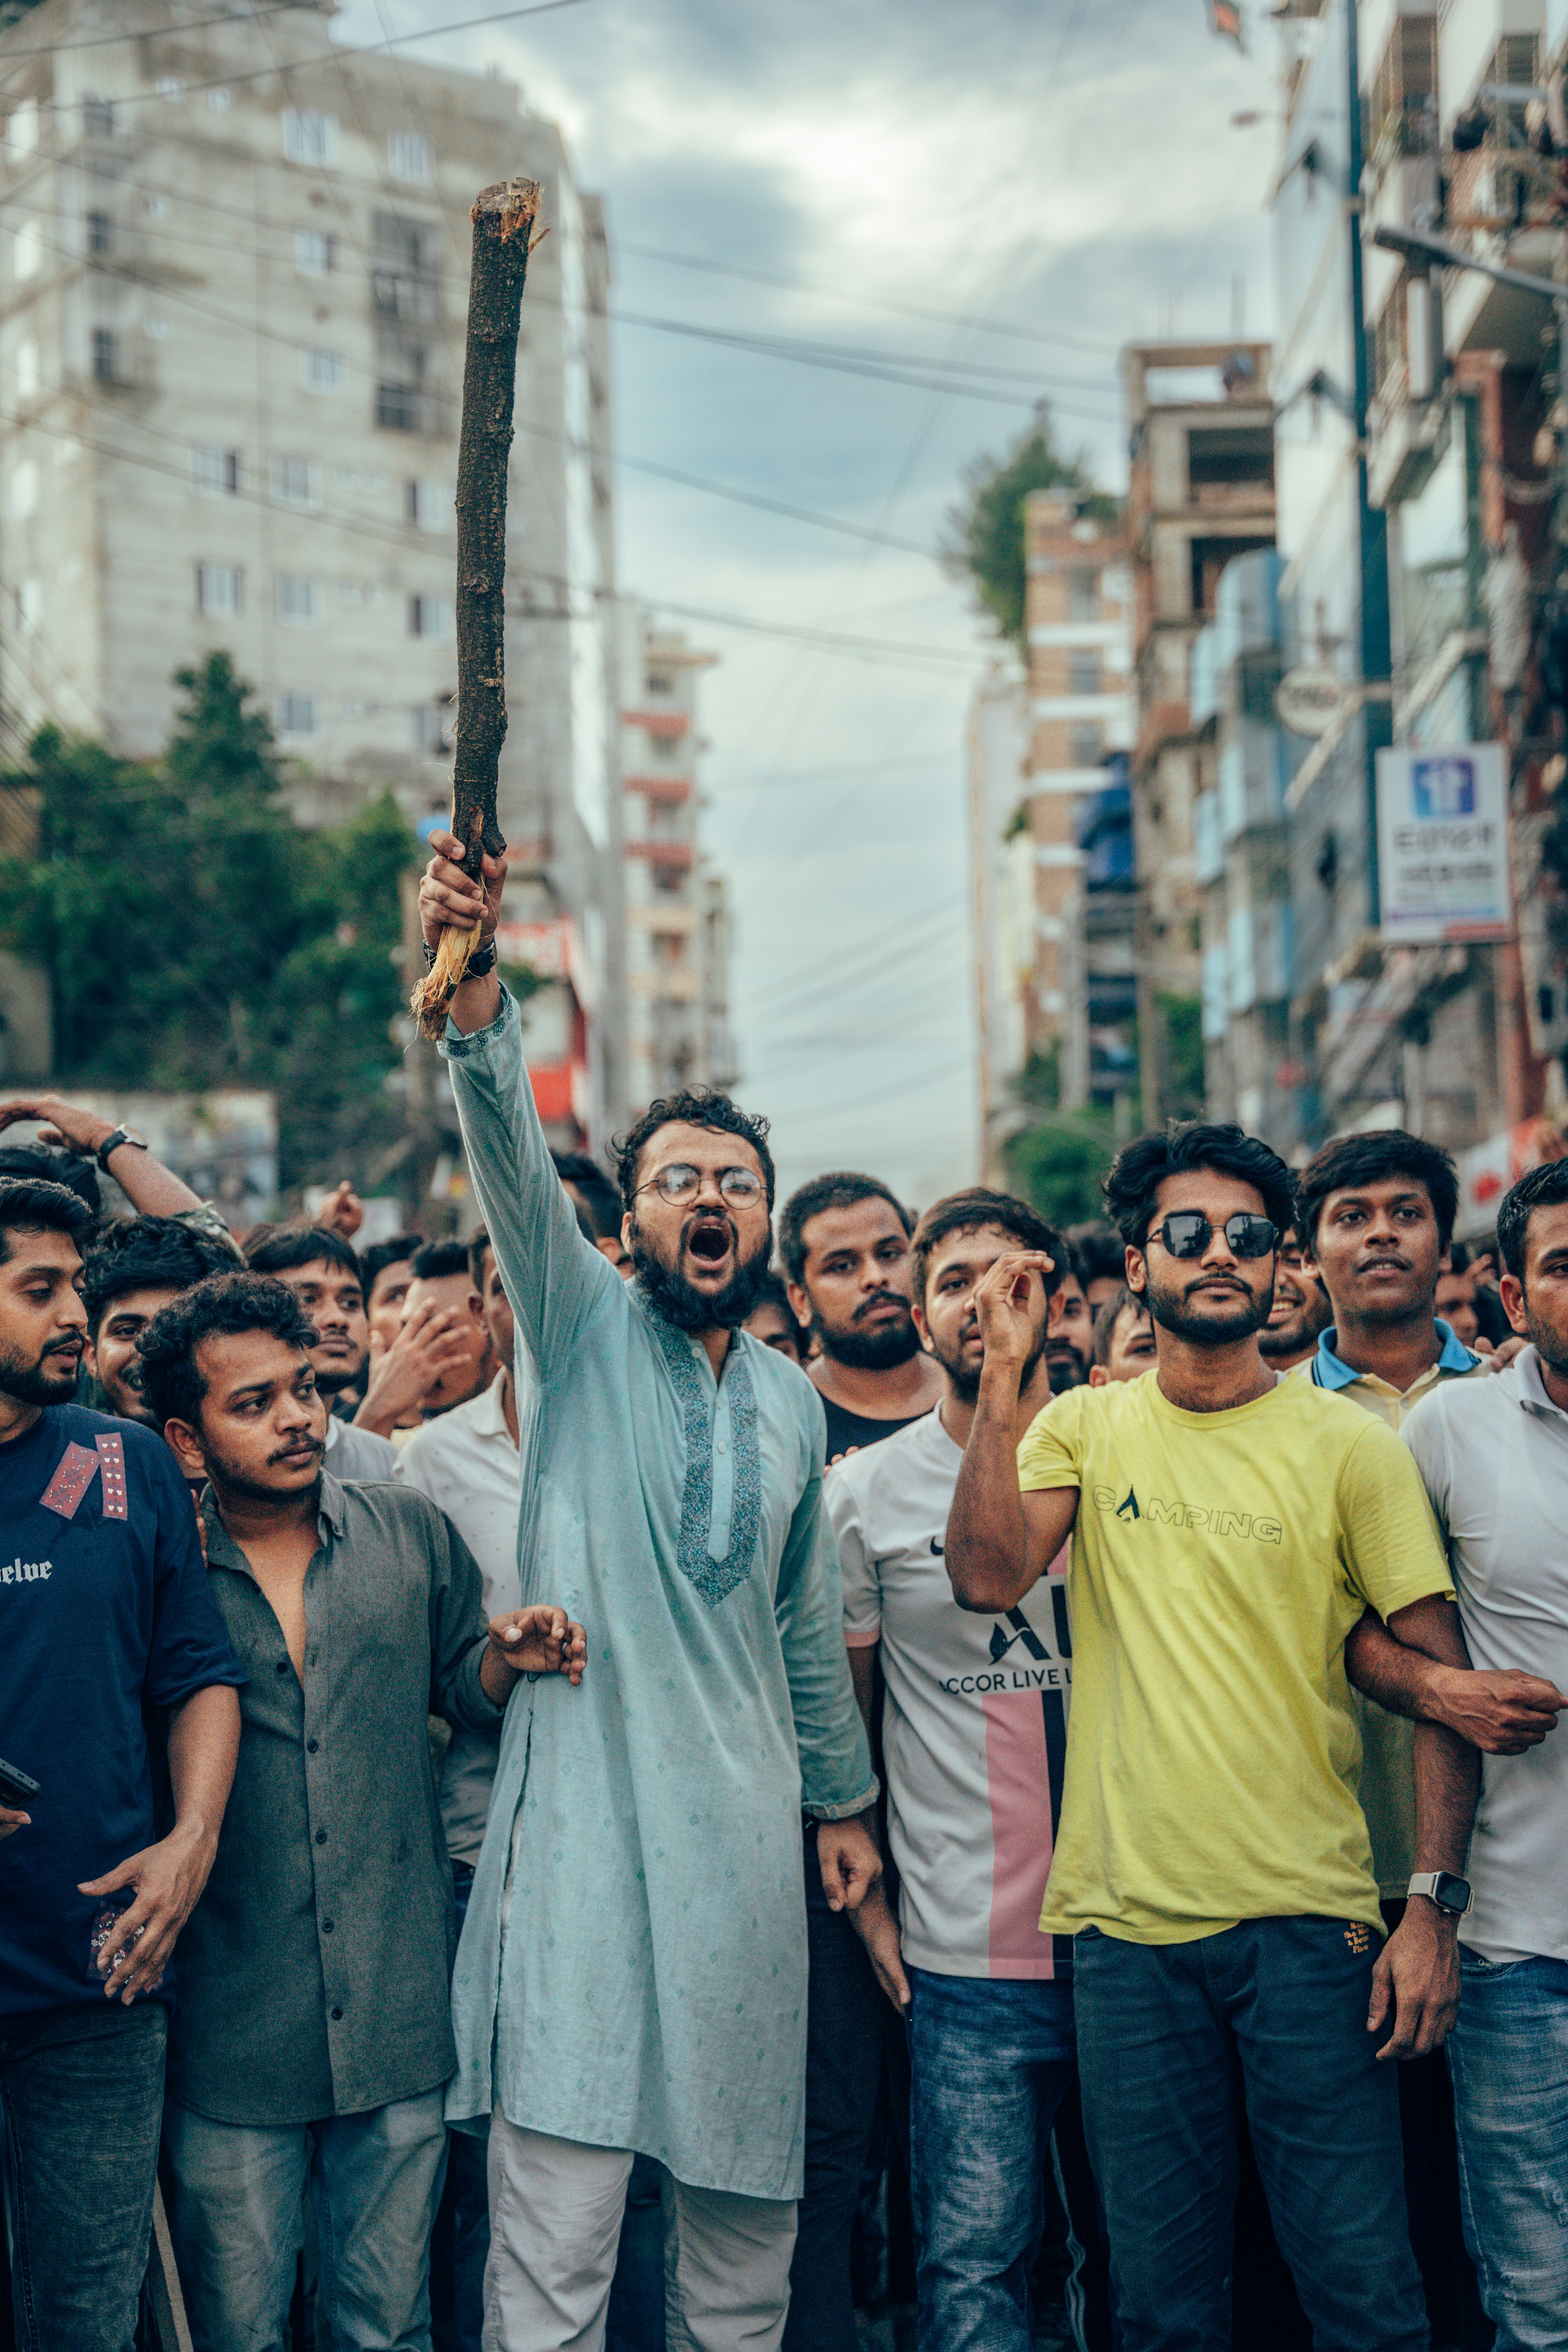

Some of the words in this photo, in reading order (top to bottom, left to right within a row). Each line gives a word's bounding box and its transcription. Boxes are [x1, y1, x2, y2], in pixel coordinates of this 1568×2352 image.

[1093, 1484, 1283, 1544] CAMPING
[0, 1557, 53, 1585] elve
[1013, 1669, 1059, 1688] LIVE
